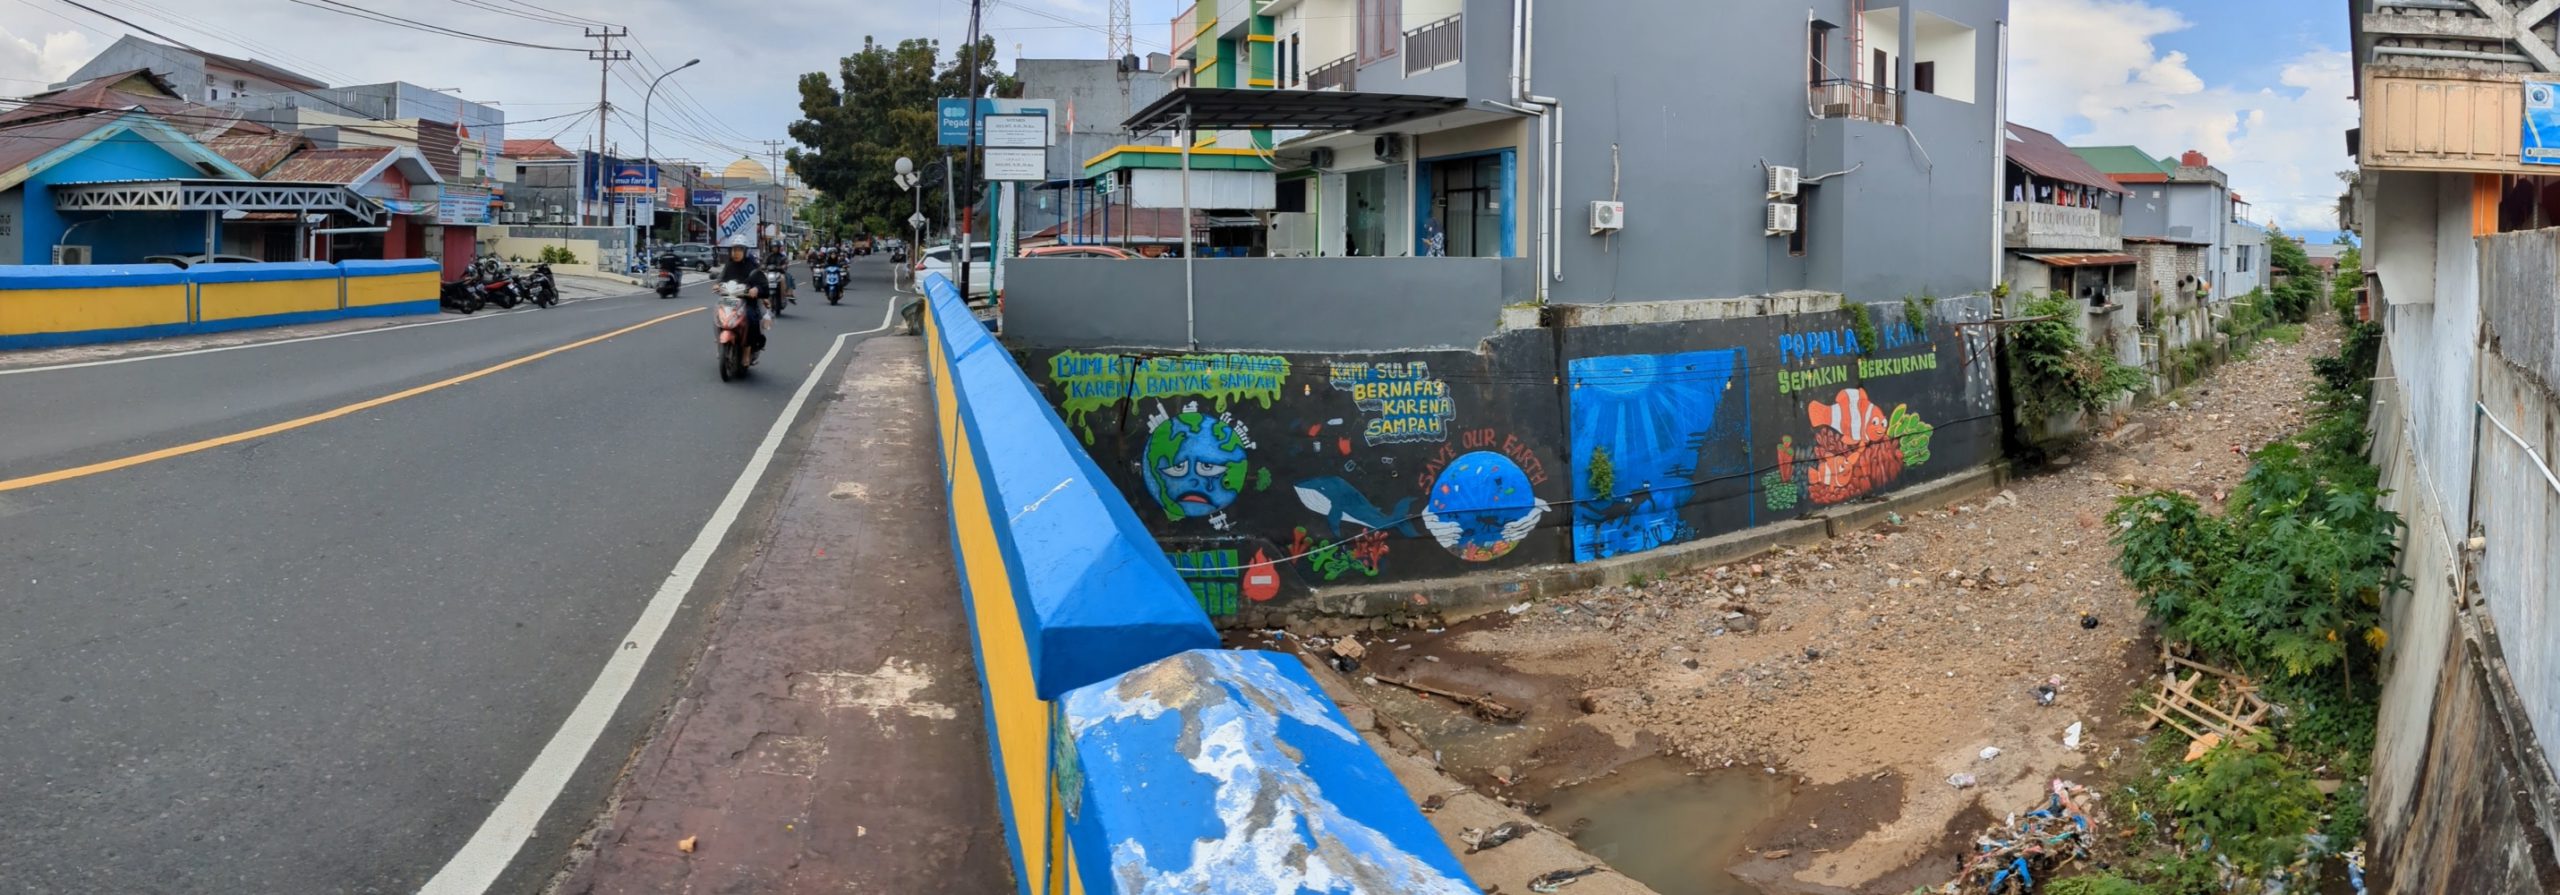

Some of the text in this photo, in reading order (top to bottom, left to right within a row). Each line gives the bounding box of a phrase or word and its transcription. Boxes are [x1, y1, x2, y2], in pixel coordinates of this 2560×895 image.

[720, 203, 756, 238] baliho
[1778, 328, 1864, 366] POPULA
[1057, 355, 1102, 378] BUMI
[1108, 356, 1150, 376] KITA
[1329, 361, 1425, 380] KAMI SULIT
[1778, 352, 1937, 394] SEMAKIN BERKURANG
[1072, 373, 1277, 398] KARENA BANYAK SAMPAH
[1354, 380, 1445, 400] BERNAFAS
[1383, 398, 1450, 415] KARENA
[1365, 418, 1440, 436] SAMPAH
[1418, 427, 1548, 495] SAVE OUR EARTH
